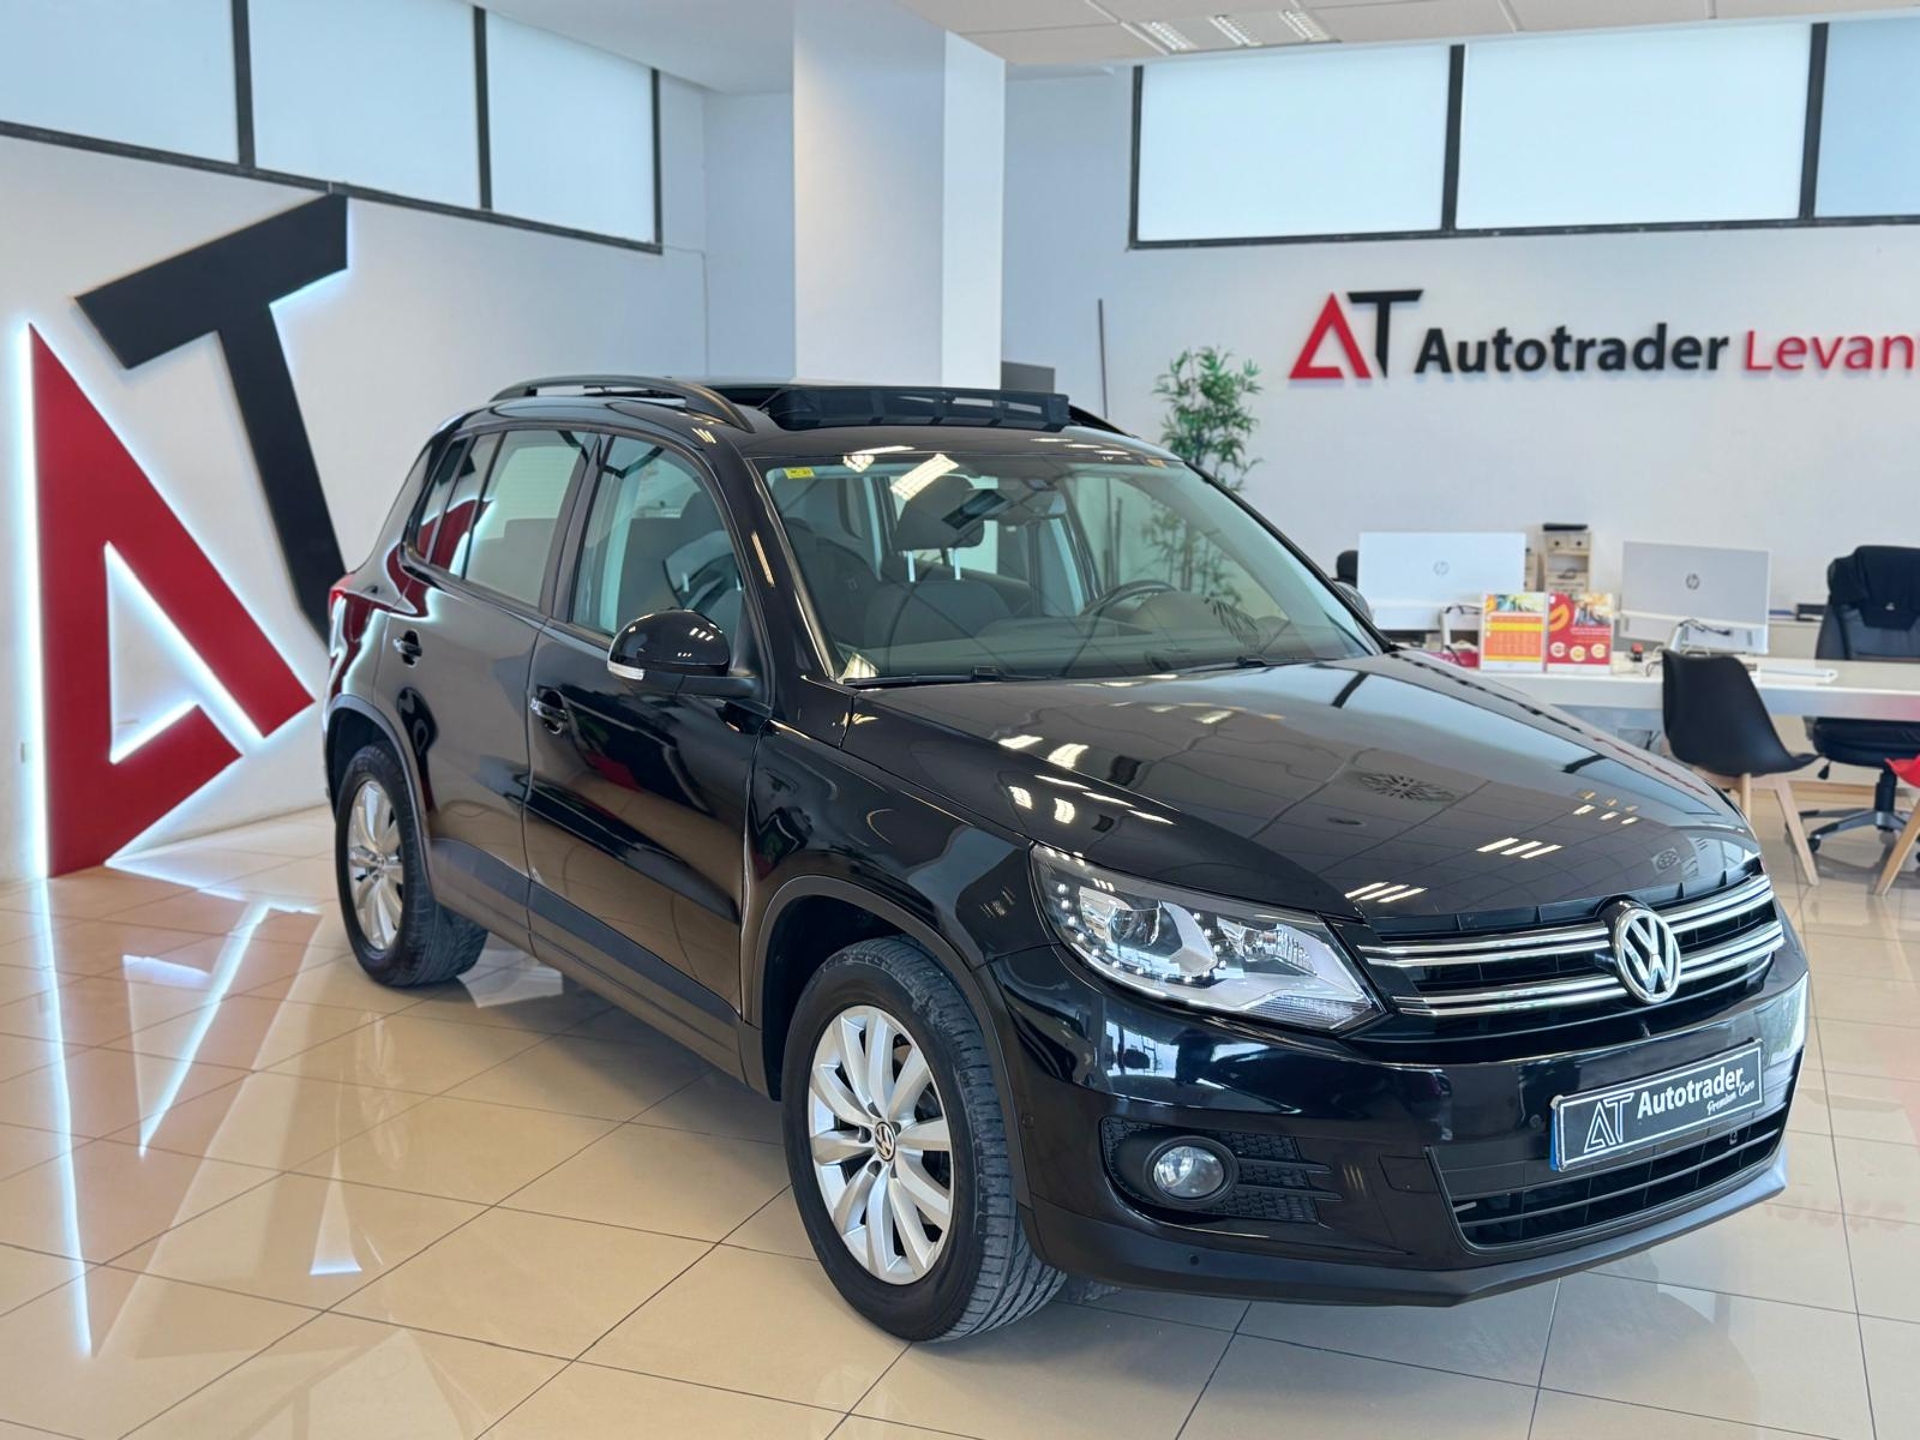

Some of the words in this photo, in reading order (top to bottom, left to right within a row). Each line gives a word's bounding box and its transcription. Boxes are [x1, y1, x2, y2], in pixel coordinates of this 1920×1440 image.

[1289, 288, 1425, 380] AT
[1415, 322, 1730, 376] Autotrader
[1583, 1091, 1635, 1154] AT
[1636, 1066, 1744, 1120] Autotrader
